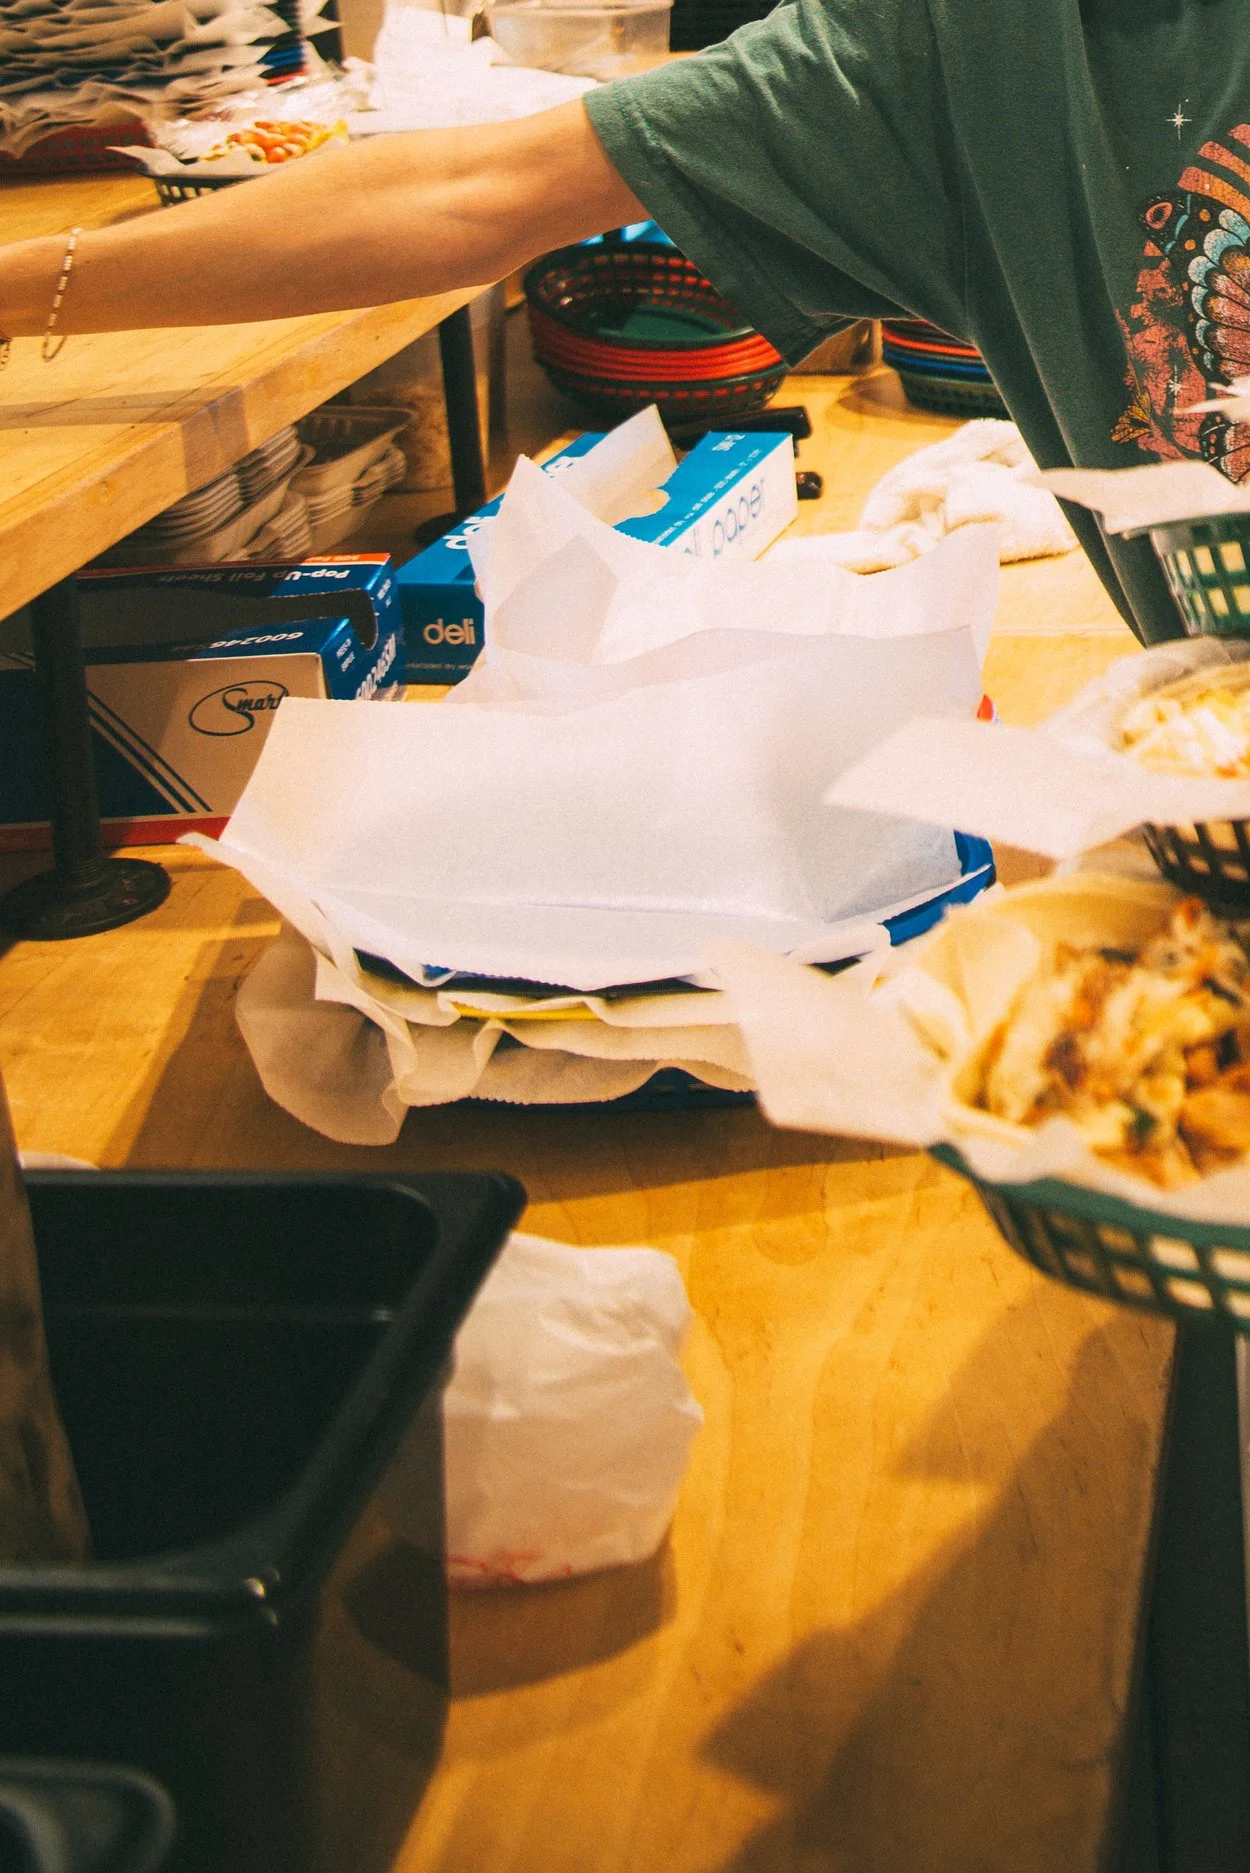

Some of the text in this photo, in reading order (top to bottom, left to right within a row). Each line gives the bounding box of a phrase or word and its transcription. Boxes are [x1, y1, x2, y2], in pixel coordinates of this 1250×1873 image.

[158, 569, 351, 583] Pop-Up Foil Sheets
[423, 617, 476, 645] deli
